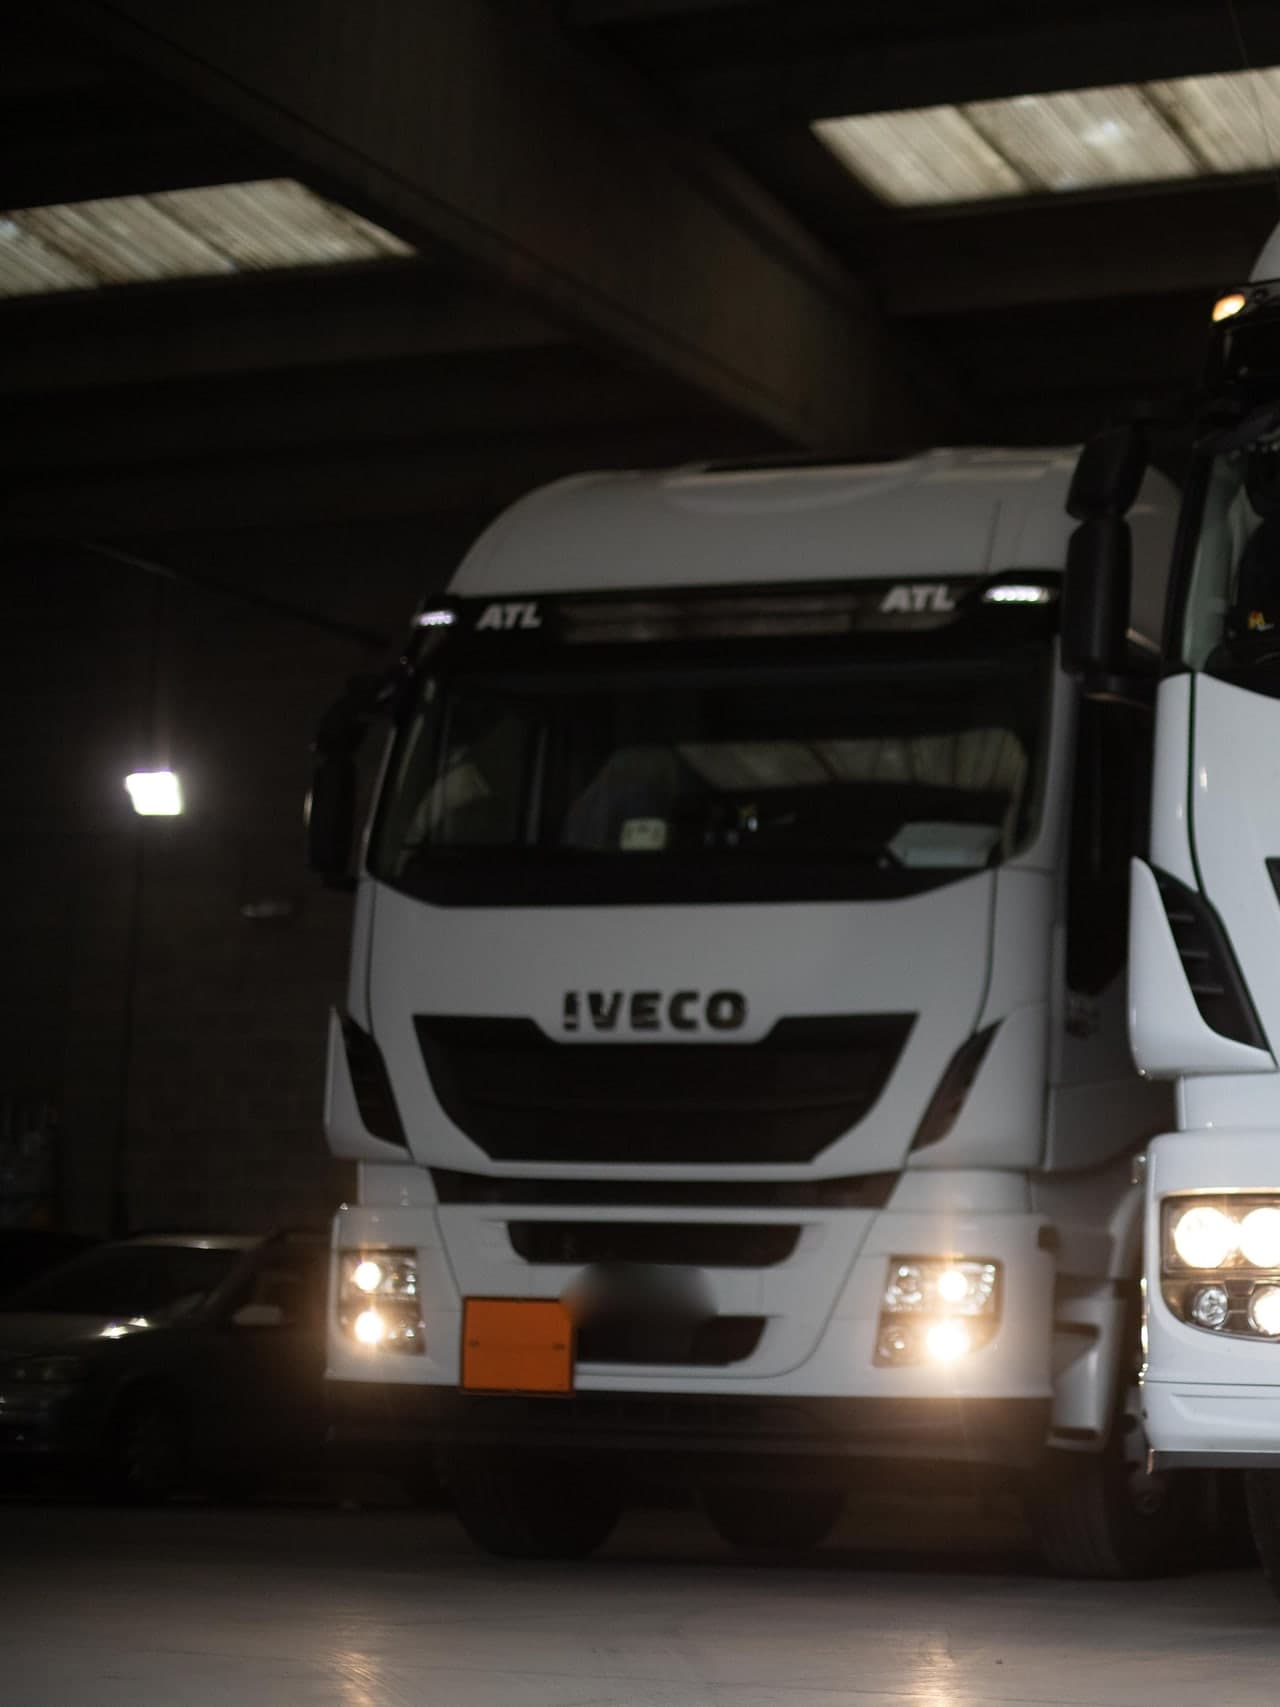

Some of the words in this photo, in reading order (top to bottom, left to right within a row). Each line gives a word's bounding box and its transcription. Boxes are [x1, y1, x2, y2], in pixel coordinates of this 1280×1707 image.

[878, 582, 957, 613] ATL
[473, 600, 544, 631] ATL
[562, 989, 748, 1032] IVECO
